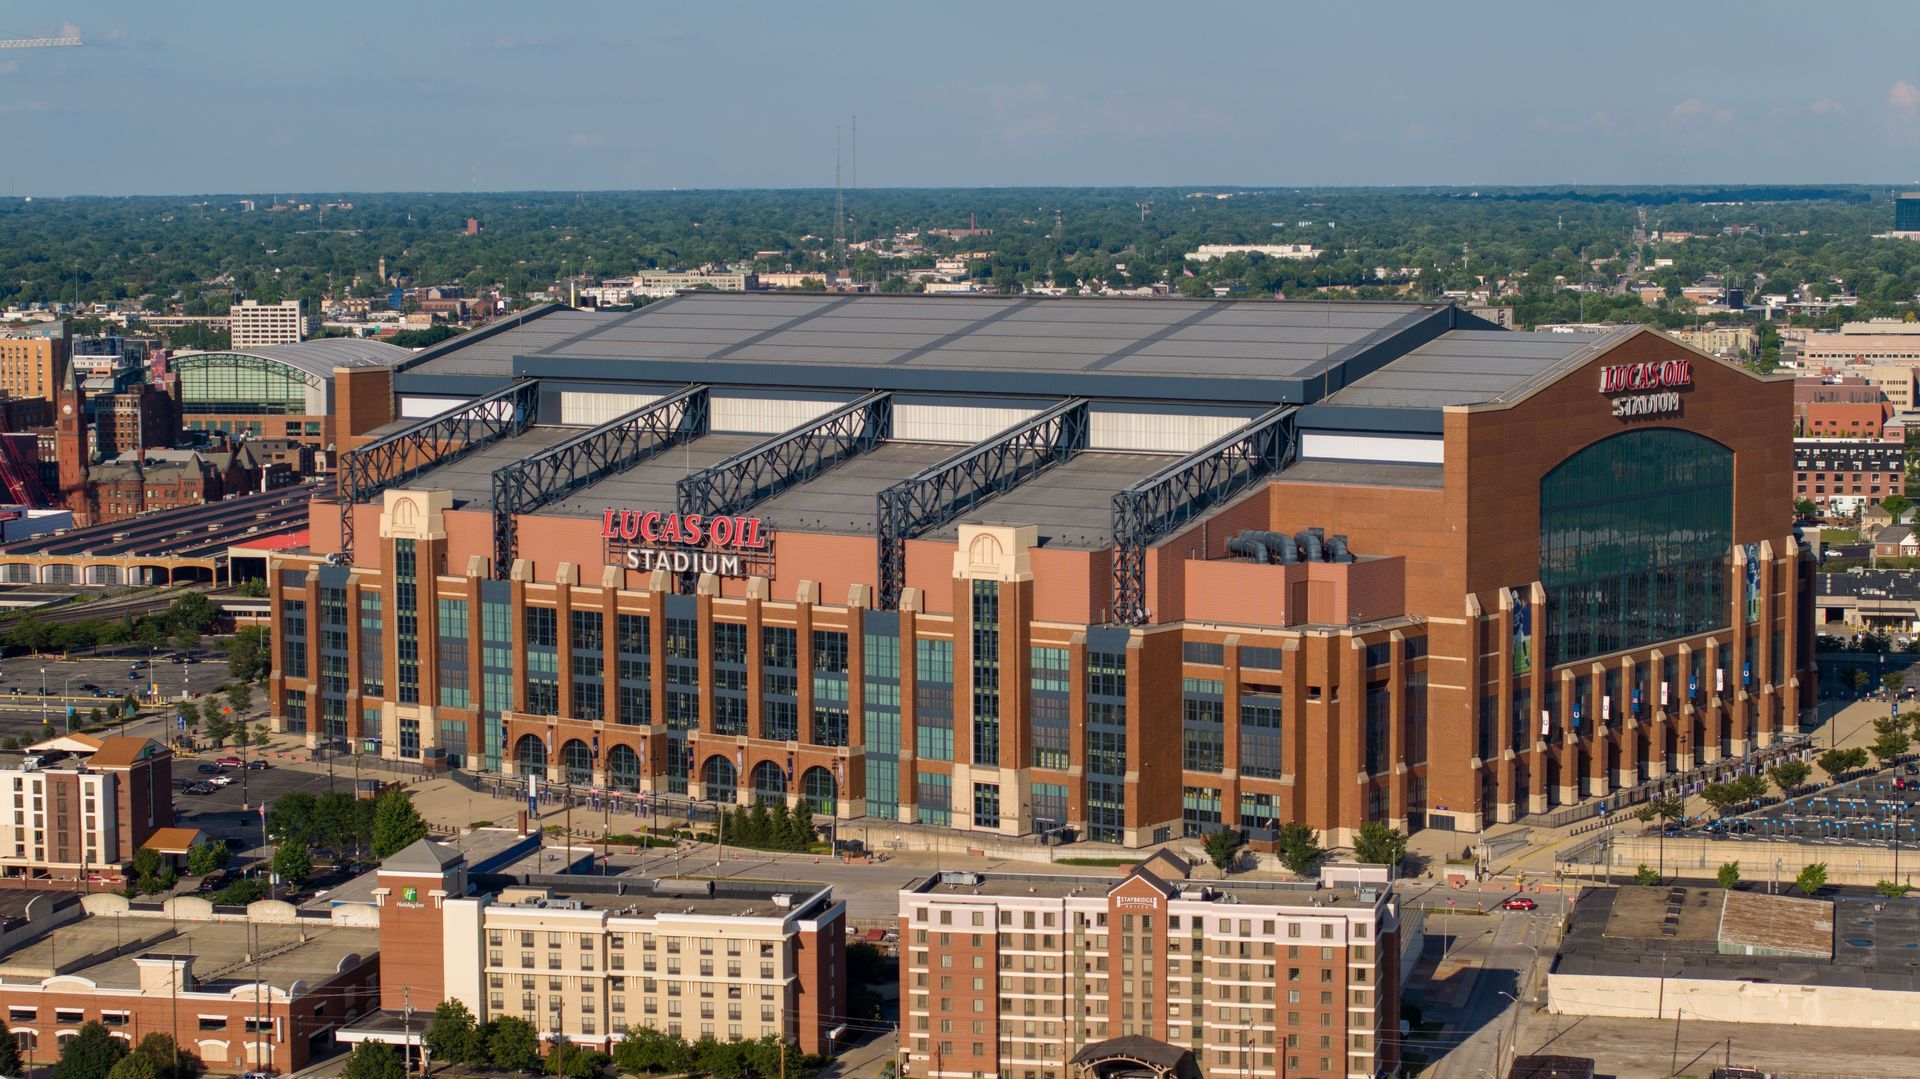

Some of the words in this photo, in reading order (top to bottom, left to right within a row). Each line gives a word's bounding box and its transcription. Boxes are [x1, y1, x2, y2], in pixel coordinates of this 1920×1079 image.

[1600, 363, 1660, 393] LUCAS
[1661, 359, 1692, 387] OIL
[1612, 392, 1679, 416] STADIUM
[601, 508, 702, 545] LUCAS
[709, 515, 765, 548] OIL
[627, 548, 738, 576] STADIUM
